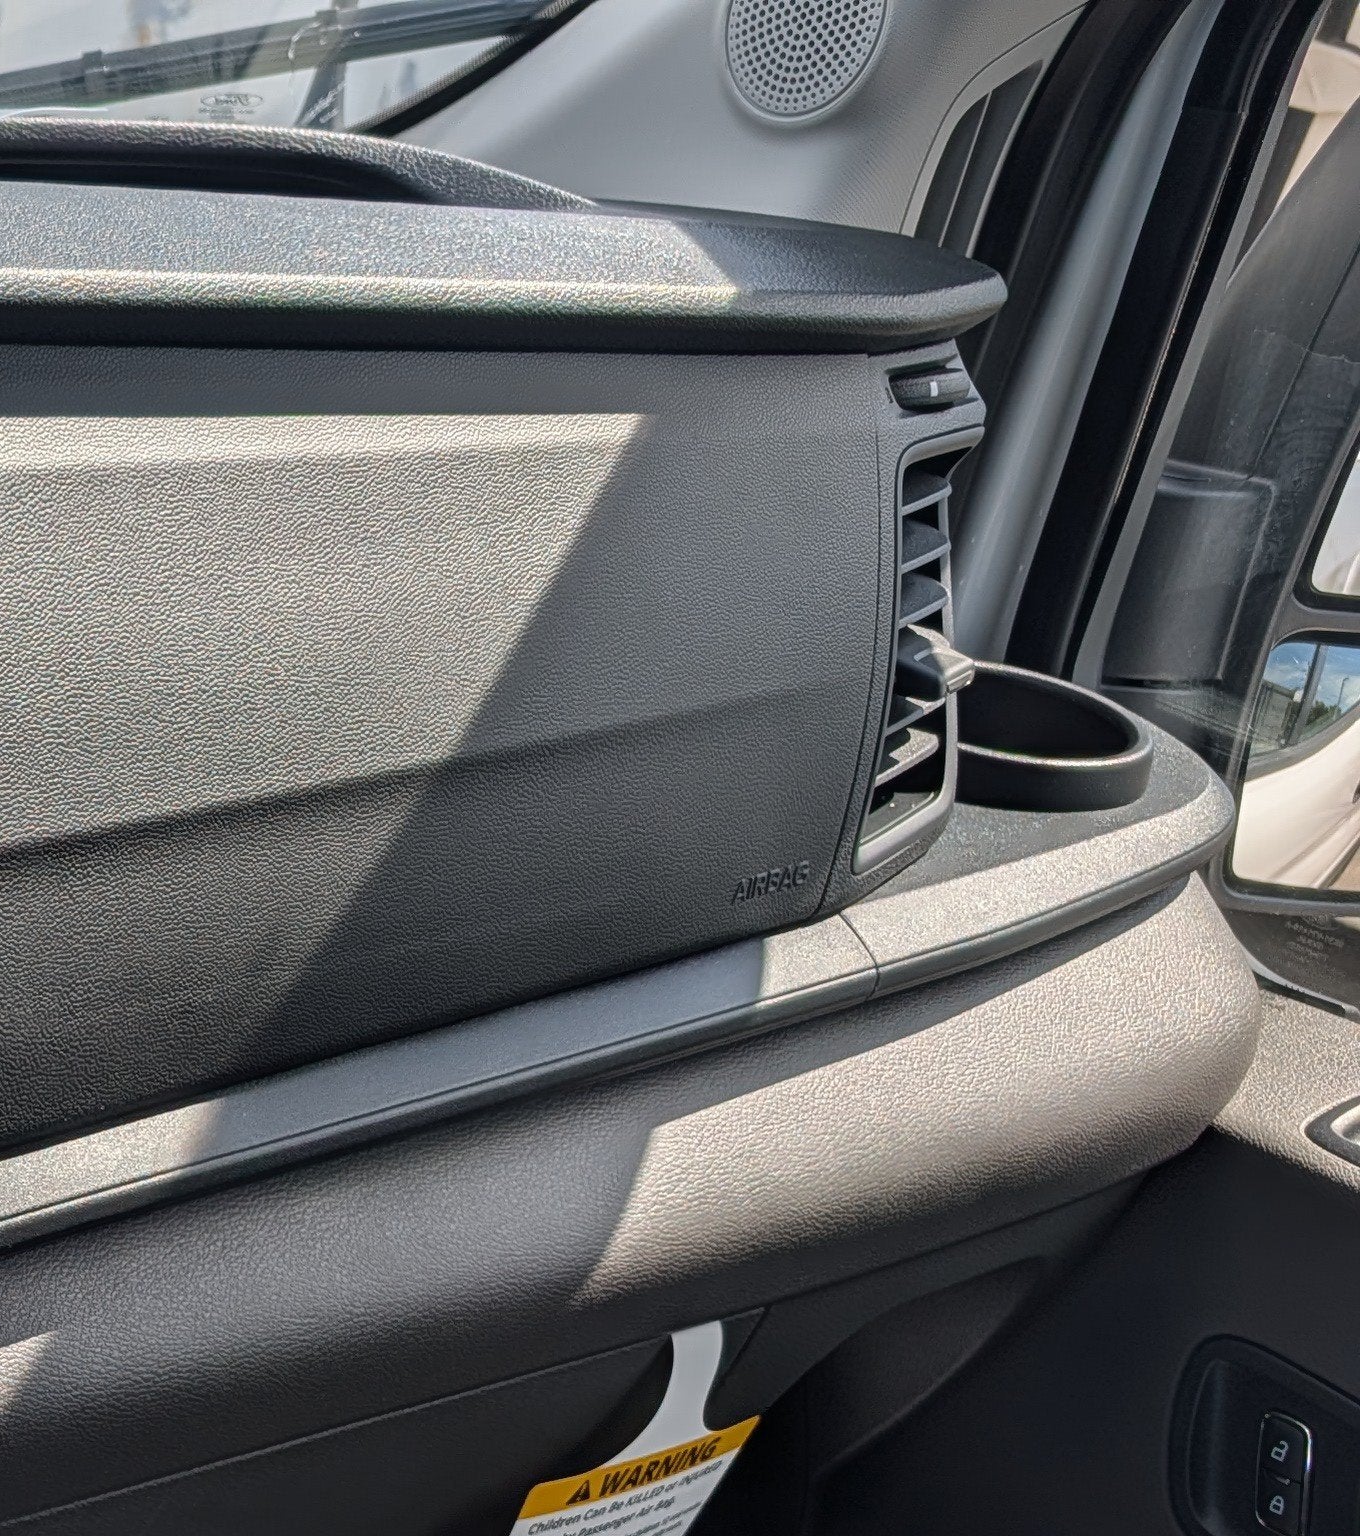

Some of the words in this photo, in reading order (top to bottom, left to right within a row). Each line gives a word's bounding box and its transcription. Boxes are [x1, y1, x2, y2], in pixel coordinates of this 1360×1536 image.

[732, 860, 809, 905] AIRBAG
[598, 1436, 722, 1497] WARNING
[528, 1513, 581, 1535] Children
[583, 1506, 607, 1521] Can
